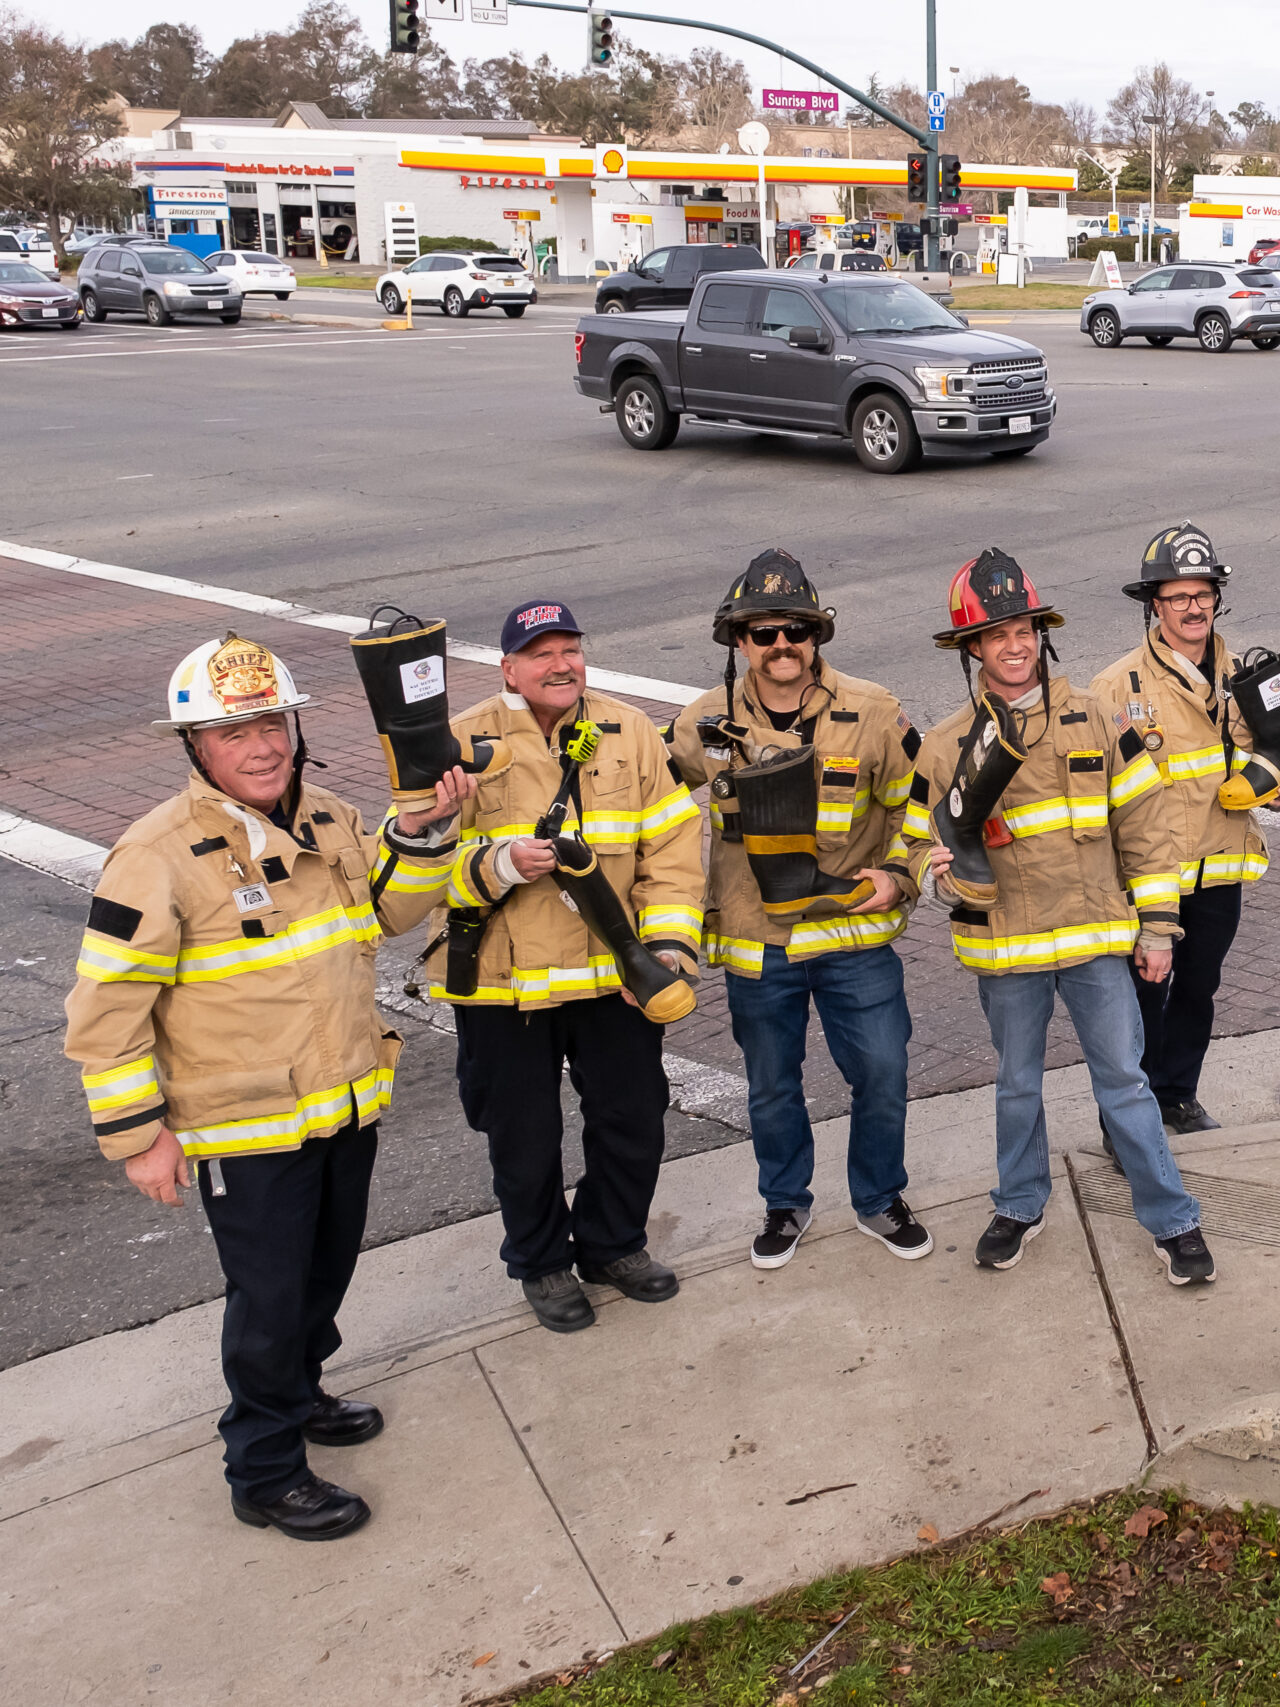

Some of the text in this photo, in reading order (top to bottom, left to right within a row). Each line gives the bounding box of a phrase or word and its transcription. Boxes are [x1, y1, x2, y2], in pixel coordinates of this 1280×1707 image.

[483, 12, 489, 20] U
[768, 93, 834, 109] Sunrise Blvd
[156, 188, 225, 199] Firestone
[168, 207, 217, 216] BRIDGESTONE
[726, 208, 748, 218] Food
[939, 205, 960, 214] Sunrise
[1246, 205, 1261, 215] Car
[517, 605, 562, 624] METRO
[525, 612, 559, 626] FIRE
[215, 653, 267, 674] CHIEF
